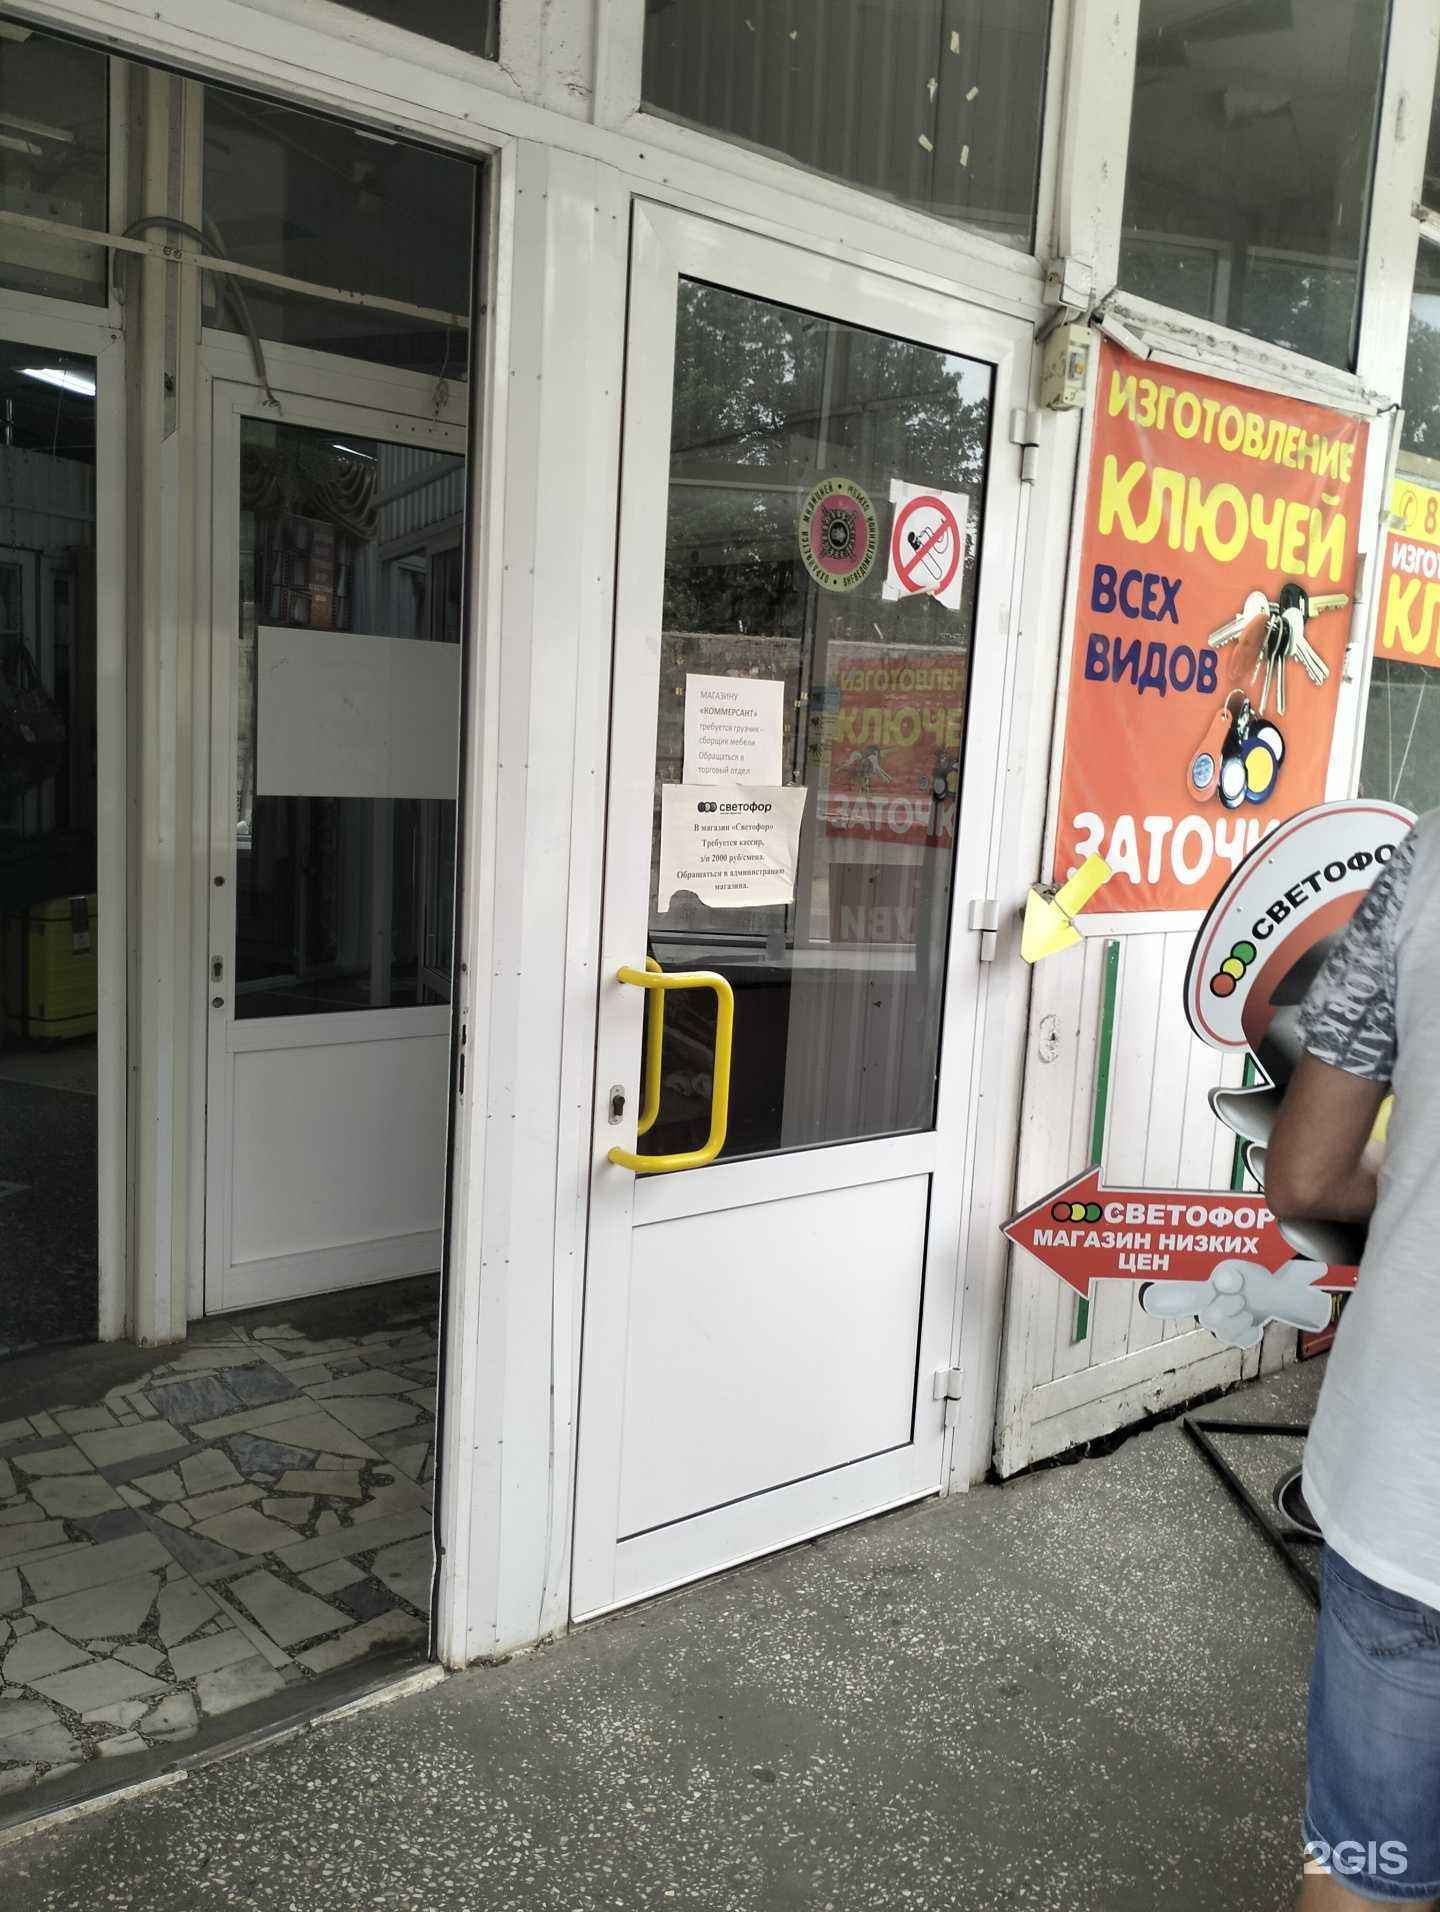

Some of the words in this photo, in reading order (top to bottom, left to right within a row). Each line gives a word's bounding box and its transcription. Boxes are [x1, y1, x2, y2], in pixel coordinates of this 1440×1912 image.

[1108, 370, 1354, 483] ИЗГОТОВЛЕНИЕ
[1099, 454, 1346, 582] КЛЮЧЕЙ
[1391, 541, 1440, 578] ИЗГО
[1091, 564, 1182, 624] ВСЕХ
[1084, 633, 1218, 698] ВИДОВ
[700, 691, 738, 701] МАГАЗИНУ
[700, 722, 732, 733] требуется
[700, 736, 728, 746] сборщик
[698, 751, 738, 761] Обращаться
[698, 766, 729, 776] торговый
[730, 768, 750, 776] отдел
[720, 801, 772, 813] светофор
[702, 839, 738, 848] Требуется
[712, 854, 727, 862] 2000
[676, 870, 722, 880] Обращаться
[1252, 843, 1397, 940] СВЕТОФО
[1104, 1202, 1275, 1230] СВЕТОФОР
[1033, 1229, 1151, 1250] МАГАЗИН
[1159, 1233, 1259, 1254] НИЗКИХ
[1118, 1253, 1170, 1272] ЦЕН
